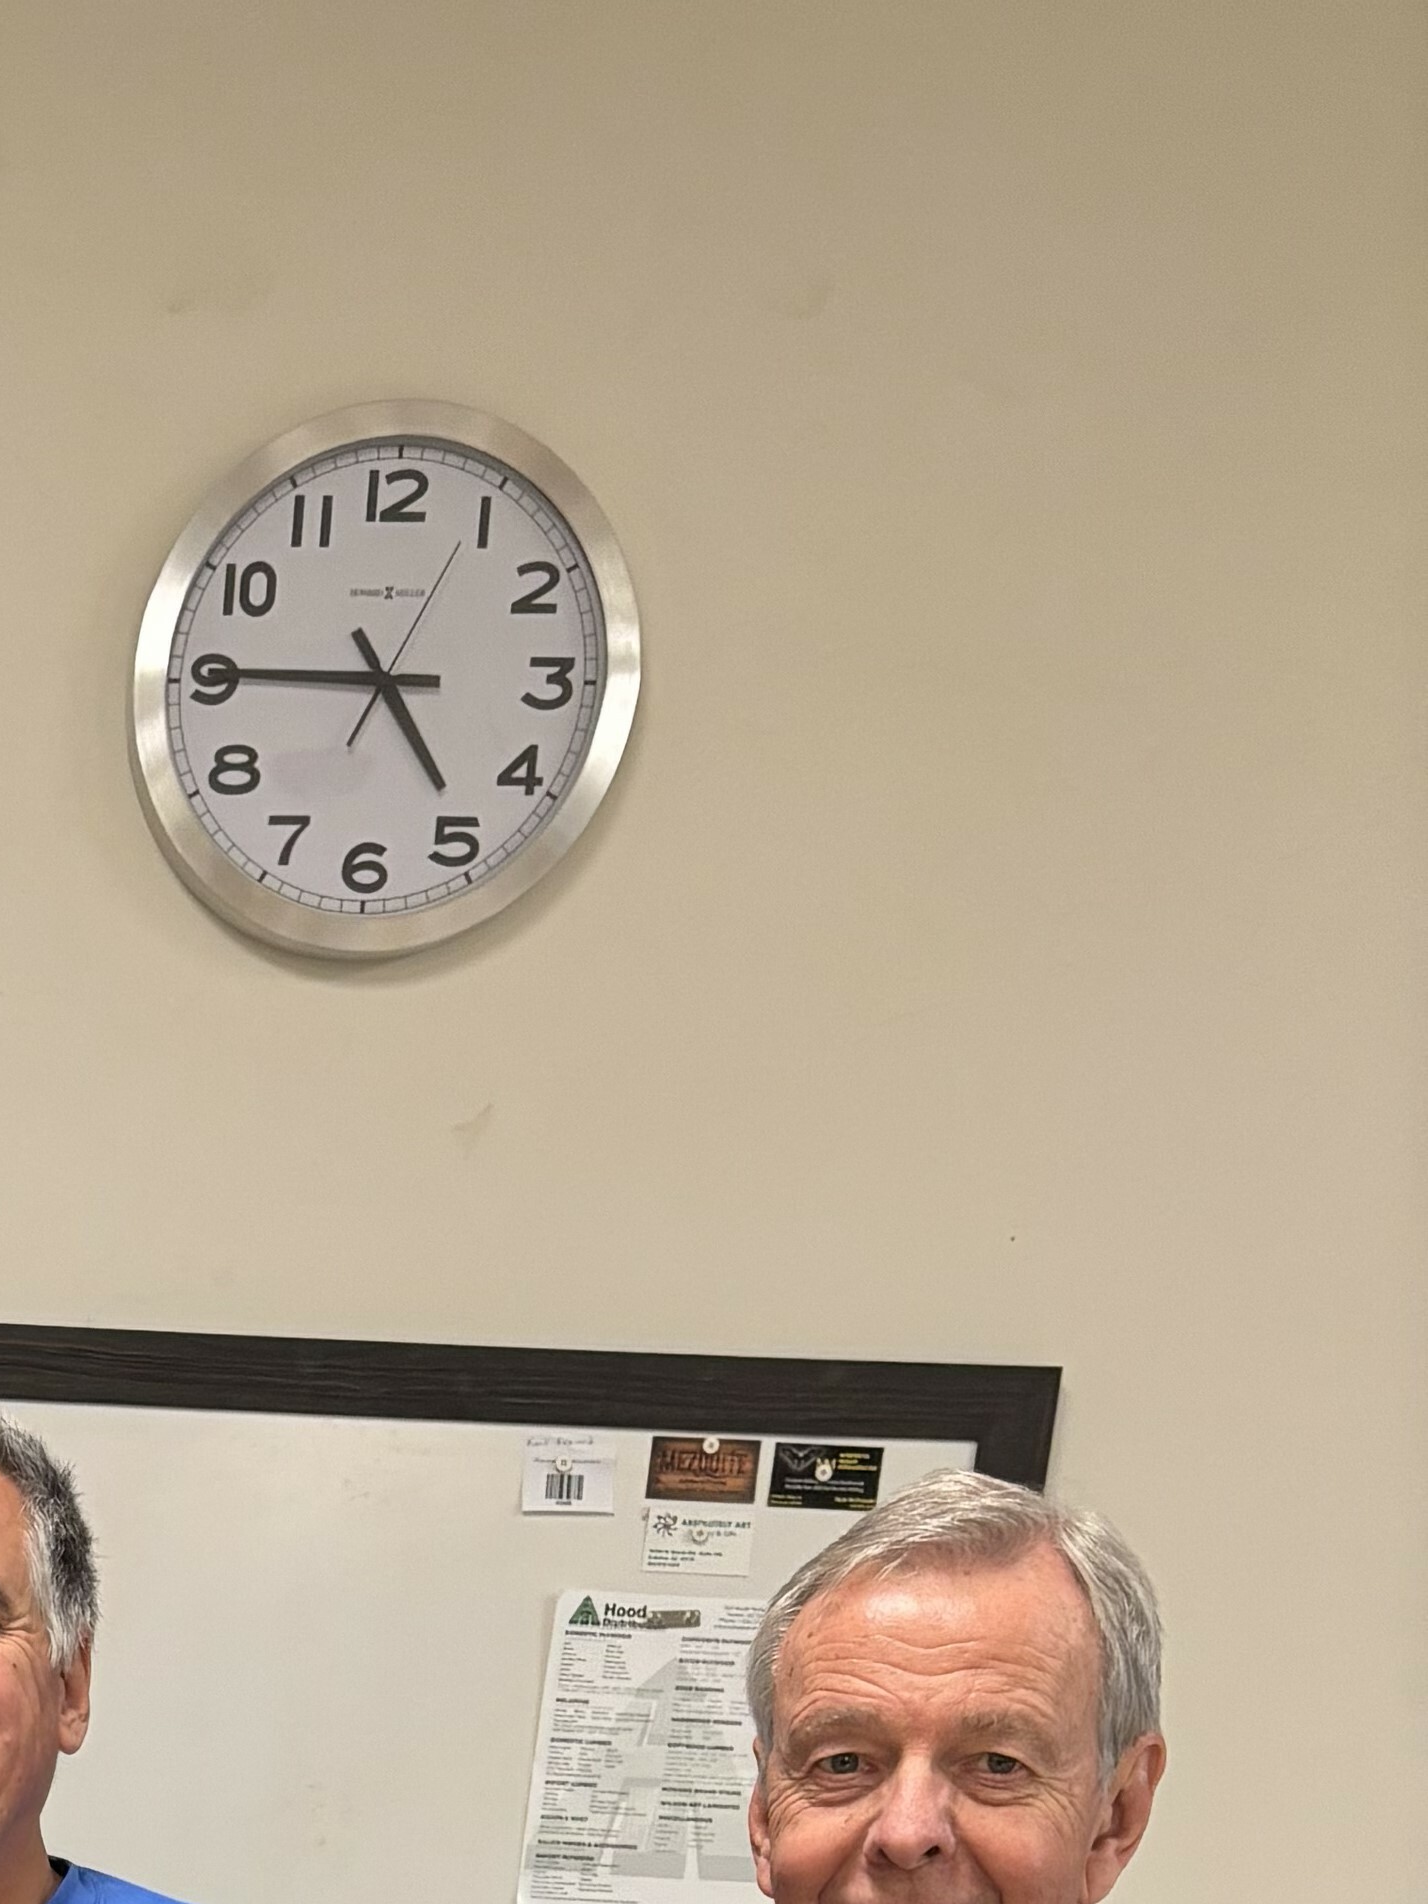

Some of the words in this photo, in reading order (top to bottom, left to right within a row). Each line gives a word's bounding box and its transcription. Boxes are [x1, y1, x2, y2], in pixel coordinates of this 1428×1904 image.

[290, 495, 333, 548] 11
[365, 468, 429, 523] 12
[477, 496, 492, 549] 1
[222, 560, 278, 618] 10
[510, 560, 561, 615] 2
[189, 652, 240, 706] 9
[520, 656, 576, 711] 3
[207, 744, 261, 796] 8
[496, 744, 543, 796] 4
[267, 815, 311, 866] 7
[427, 815, 481, 868] 5
[341, 841, 388, 894] 6
[604, 1603, 647, 1619] Hood
